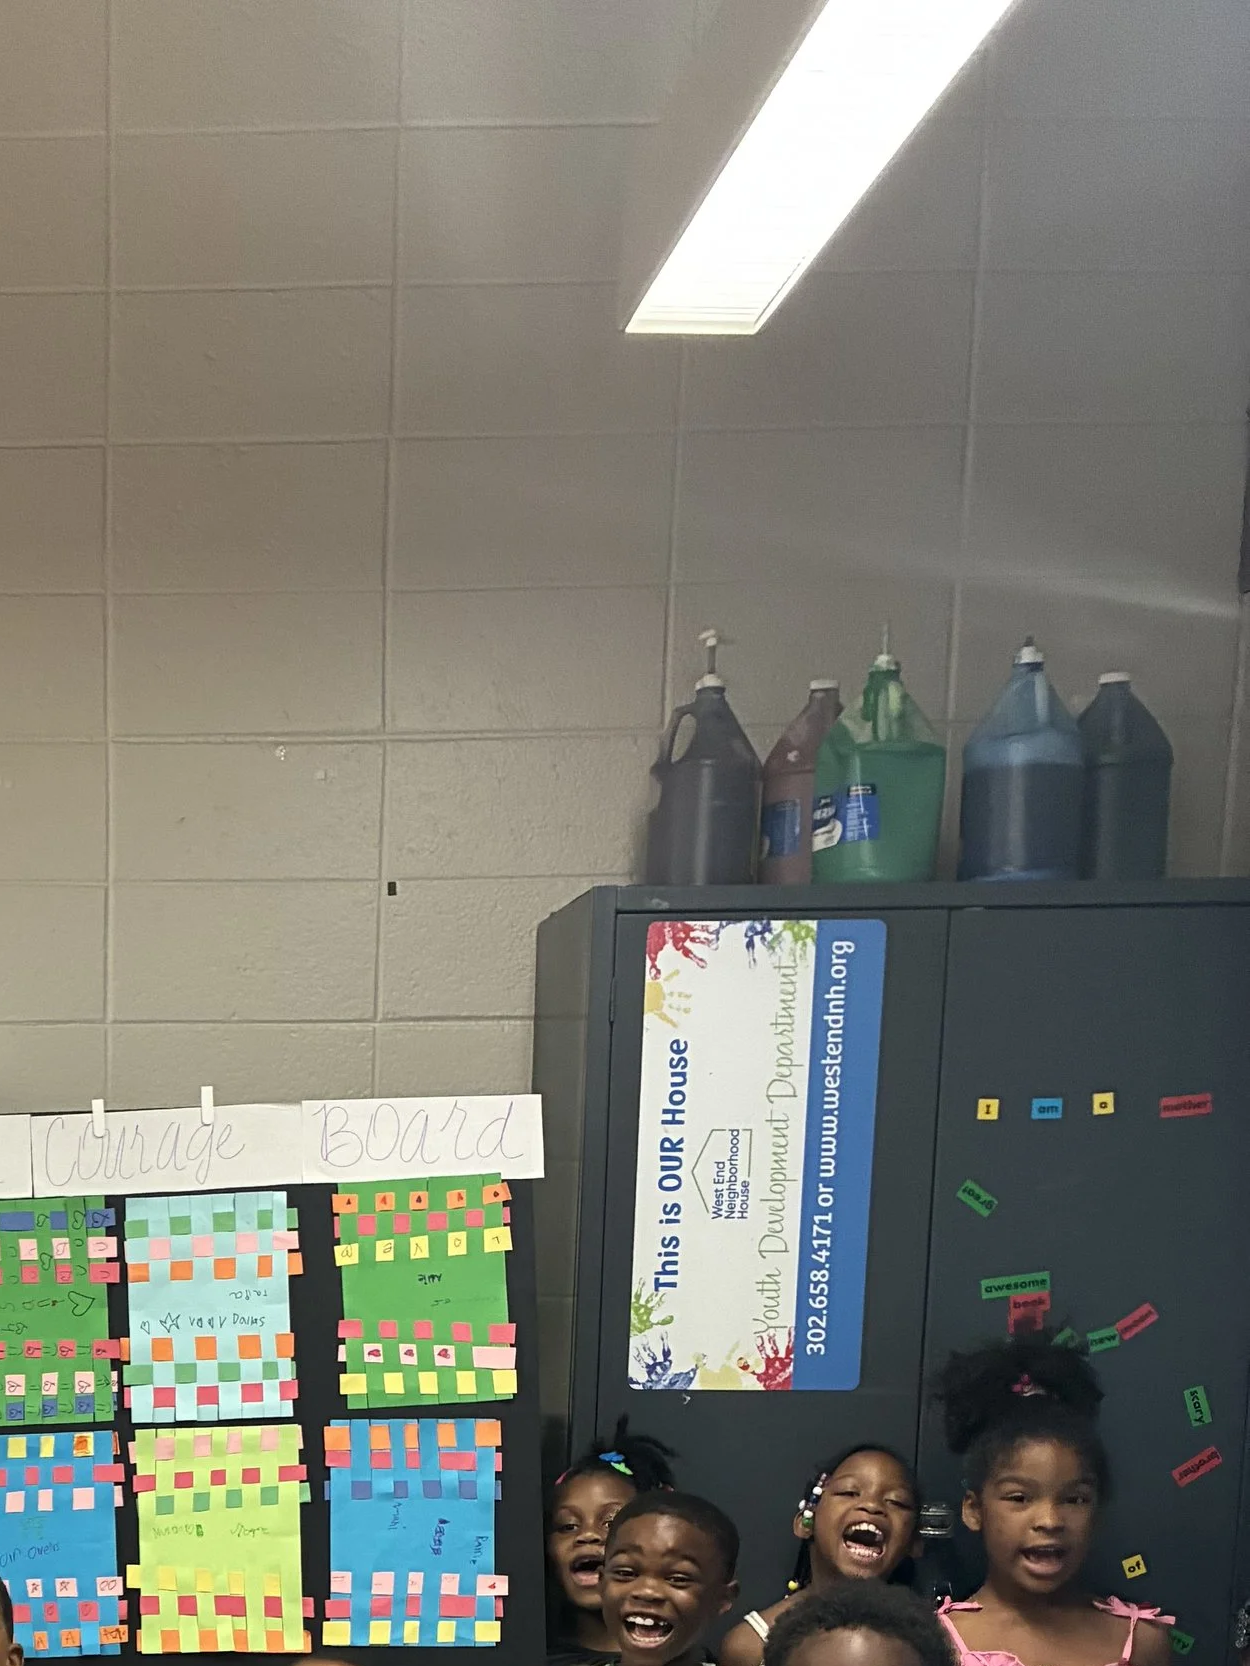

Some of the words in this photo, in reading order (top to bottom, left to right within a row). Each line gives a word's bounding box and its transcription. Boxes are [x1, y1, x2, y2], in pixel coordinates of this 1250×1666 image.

[765, 956, 803, 1104] Department
[660, 1038, 688, 1126] House
[818, 940, 856, 1178] www.westendnh.org
[1037, 1103, 1059, 1114] am
[657, 1136, 685, 1192] OUR
[712, 1160, 726, 1185] End
[723, 1128, 741, 1220] Neighborhood
[757, 1109, 797, 1259] Development
[658, 1202, 682, 1225] is
[711, 1187, 726, 1220] West
[737, 1180, 751, 1220] House
[815, 1182, 835, 1207] or
[653, 1235, 681, 1292] This
[806, 1212, 834, 1356] 302.658.4171
[983, 1276, 1048, 1294] awesome
[753, 1266, 787, 1334] Youth
[1189, 1389, 1206, 1424] scary
[1127, 1560, 1142, 1573] of
